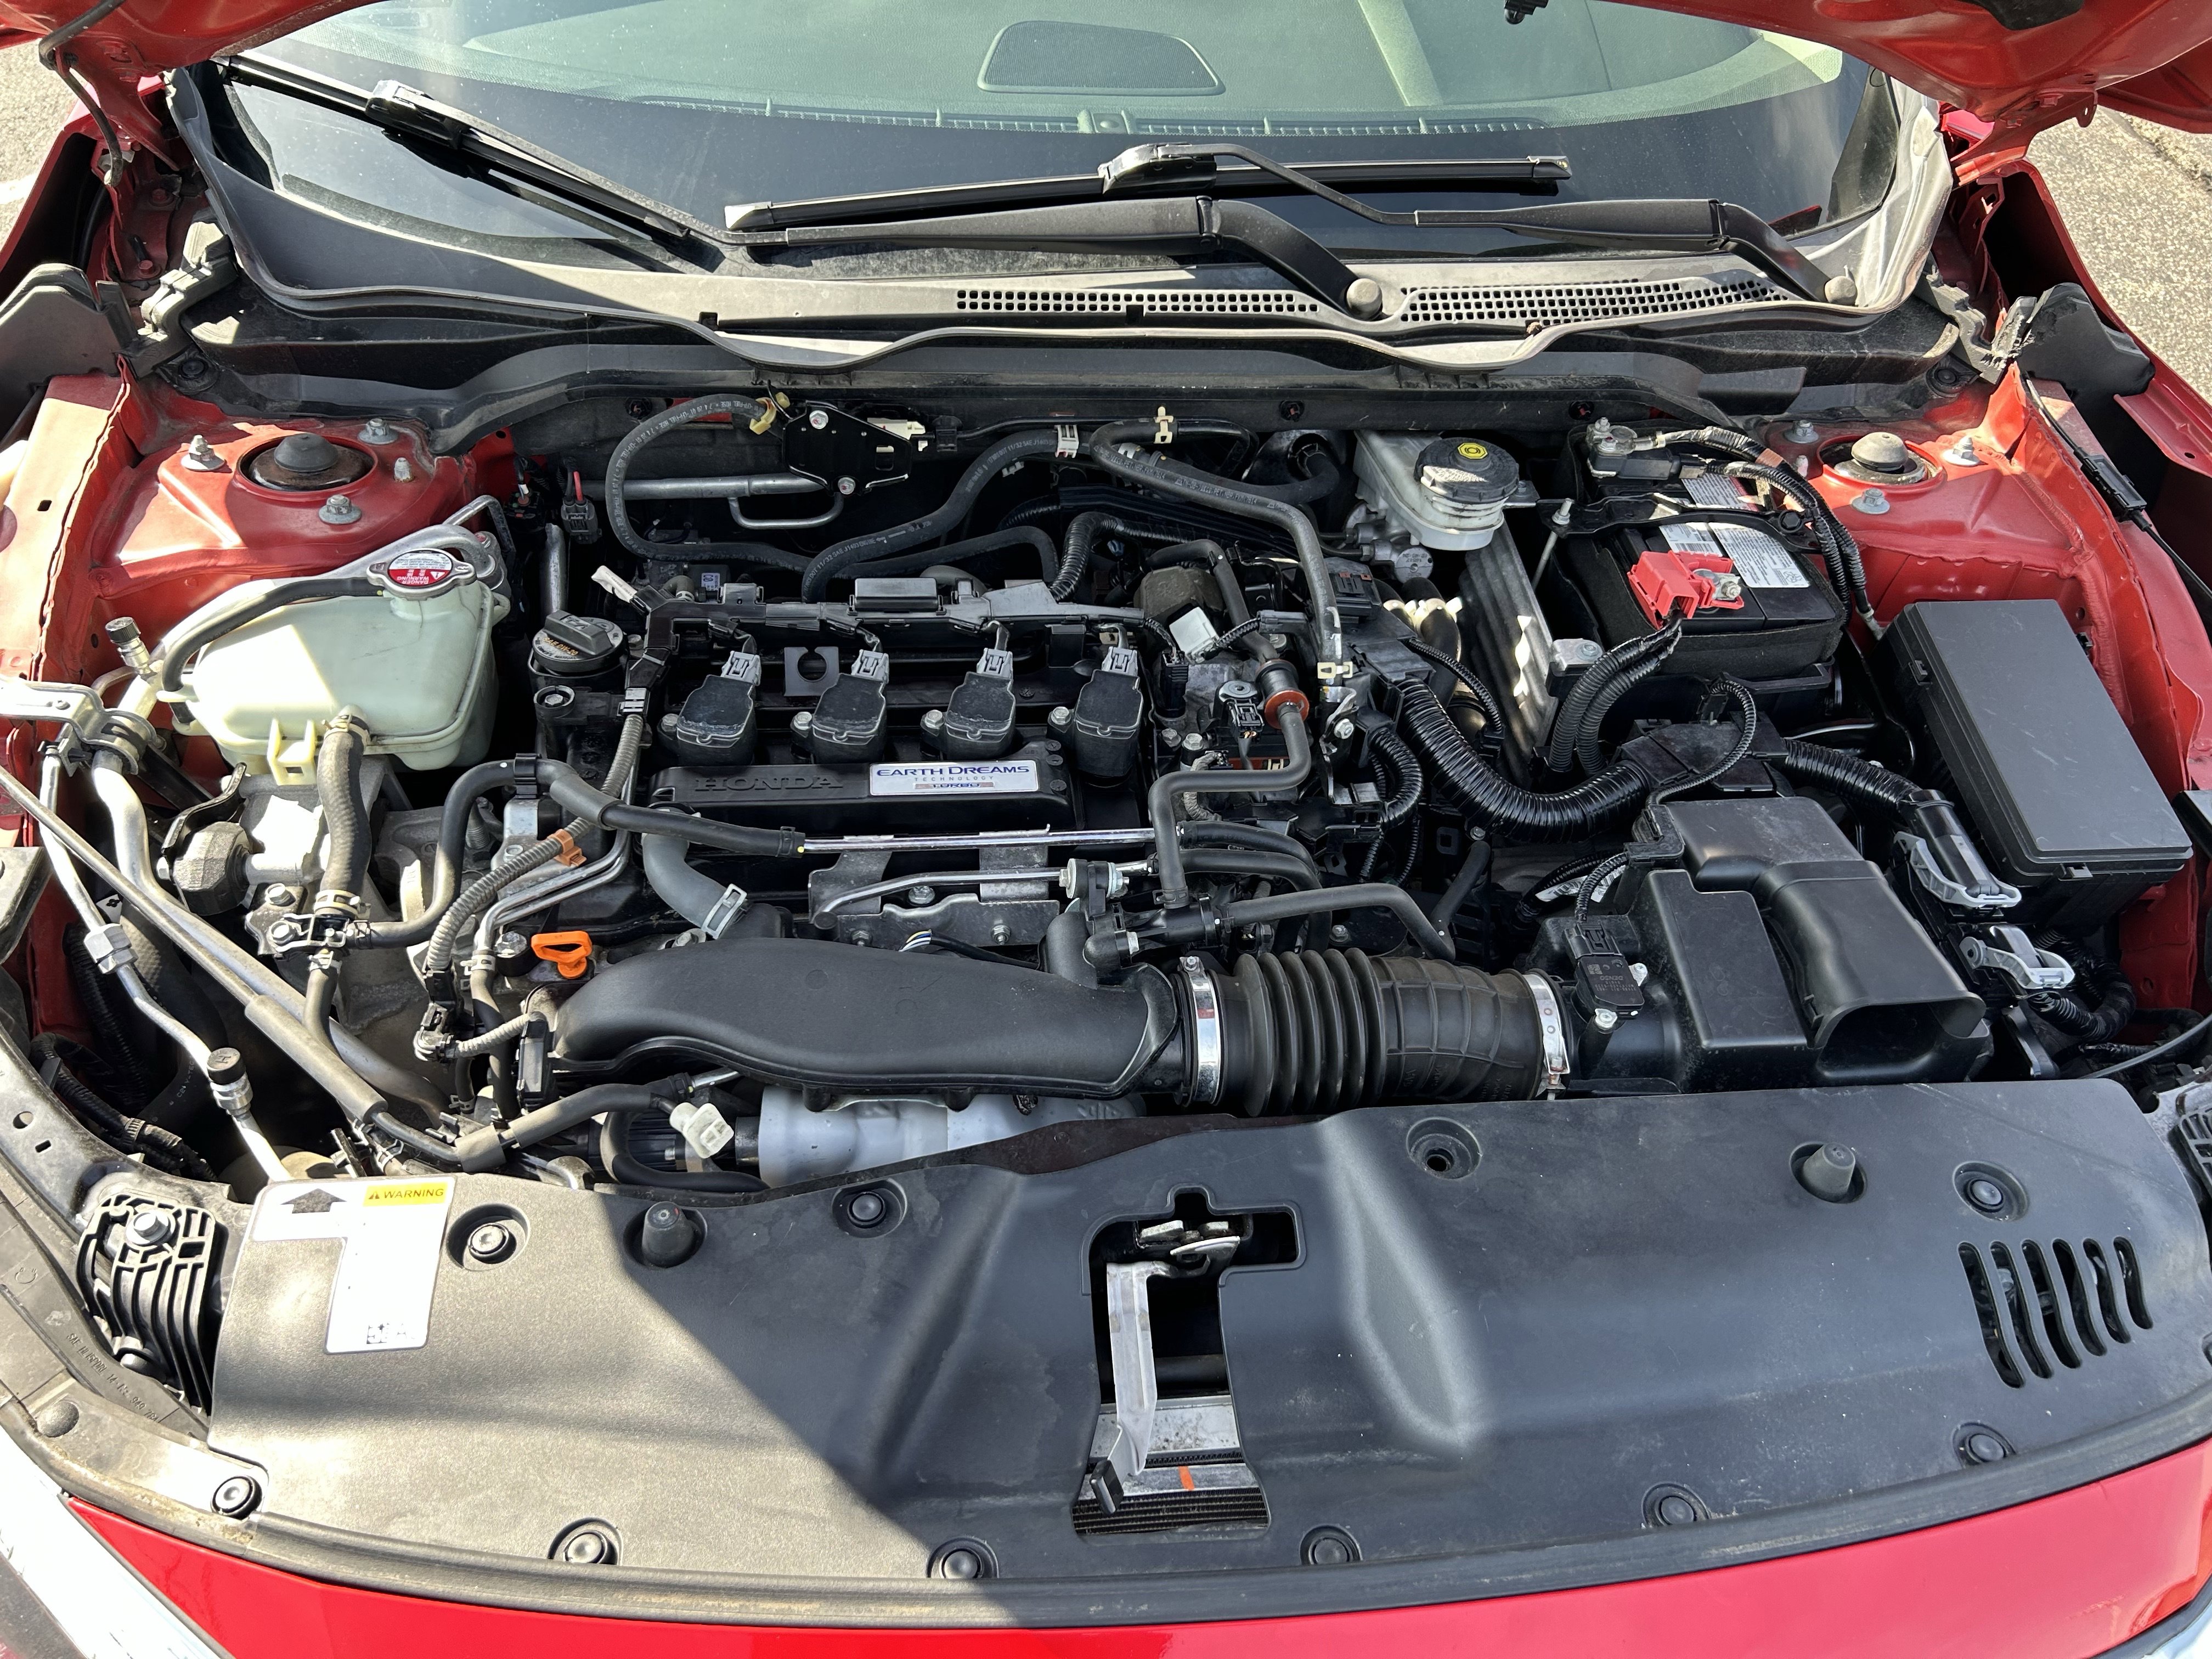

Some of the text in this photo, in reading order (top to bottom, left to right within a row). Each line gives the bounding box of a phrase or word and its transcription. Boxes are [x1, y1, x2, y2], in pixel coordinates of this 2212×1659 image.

[543, 637, 560, 646] SAE
[557, 644, 579, 656] 0W-20
[876, 765, 1030, 776] EARTH DREAMS
[694, 774, 844, 793] HONDA
[383, 1188, 444, 1200] WARNING
[67, 1333, 82, 1346] SAE
